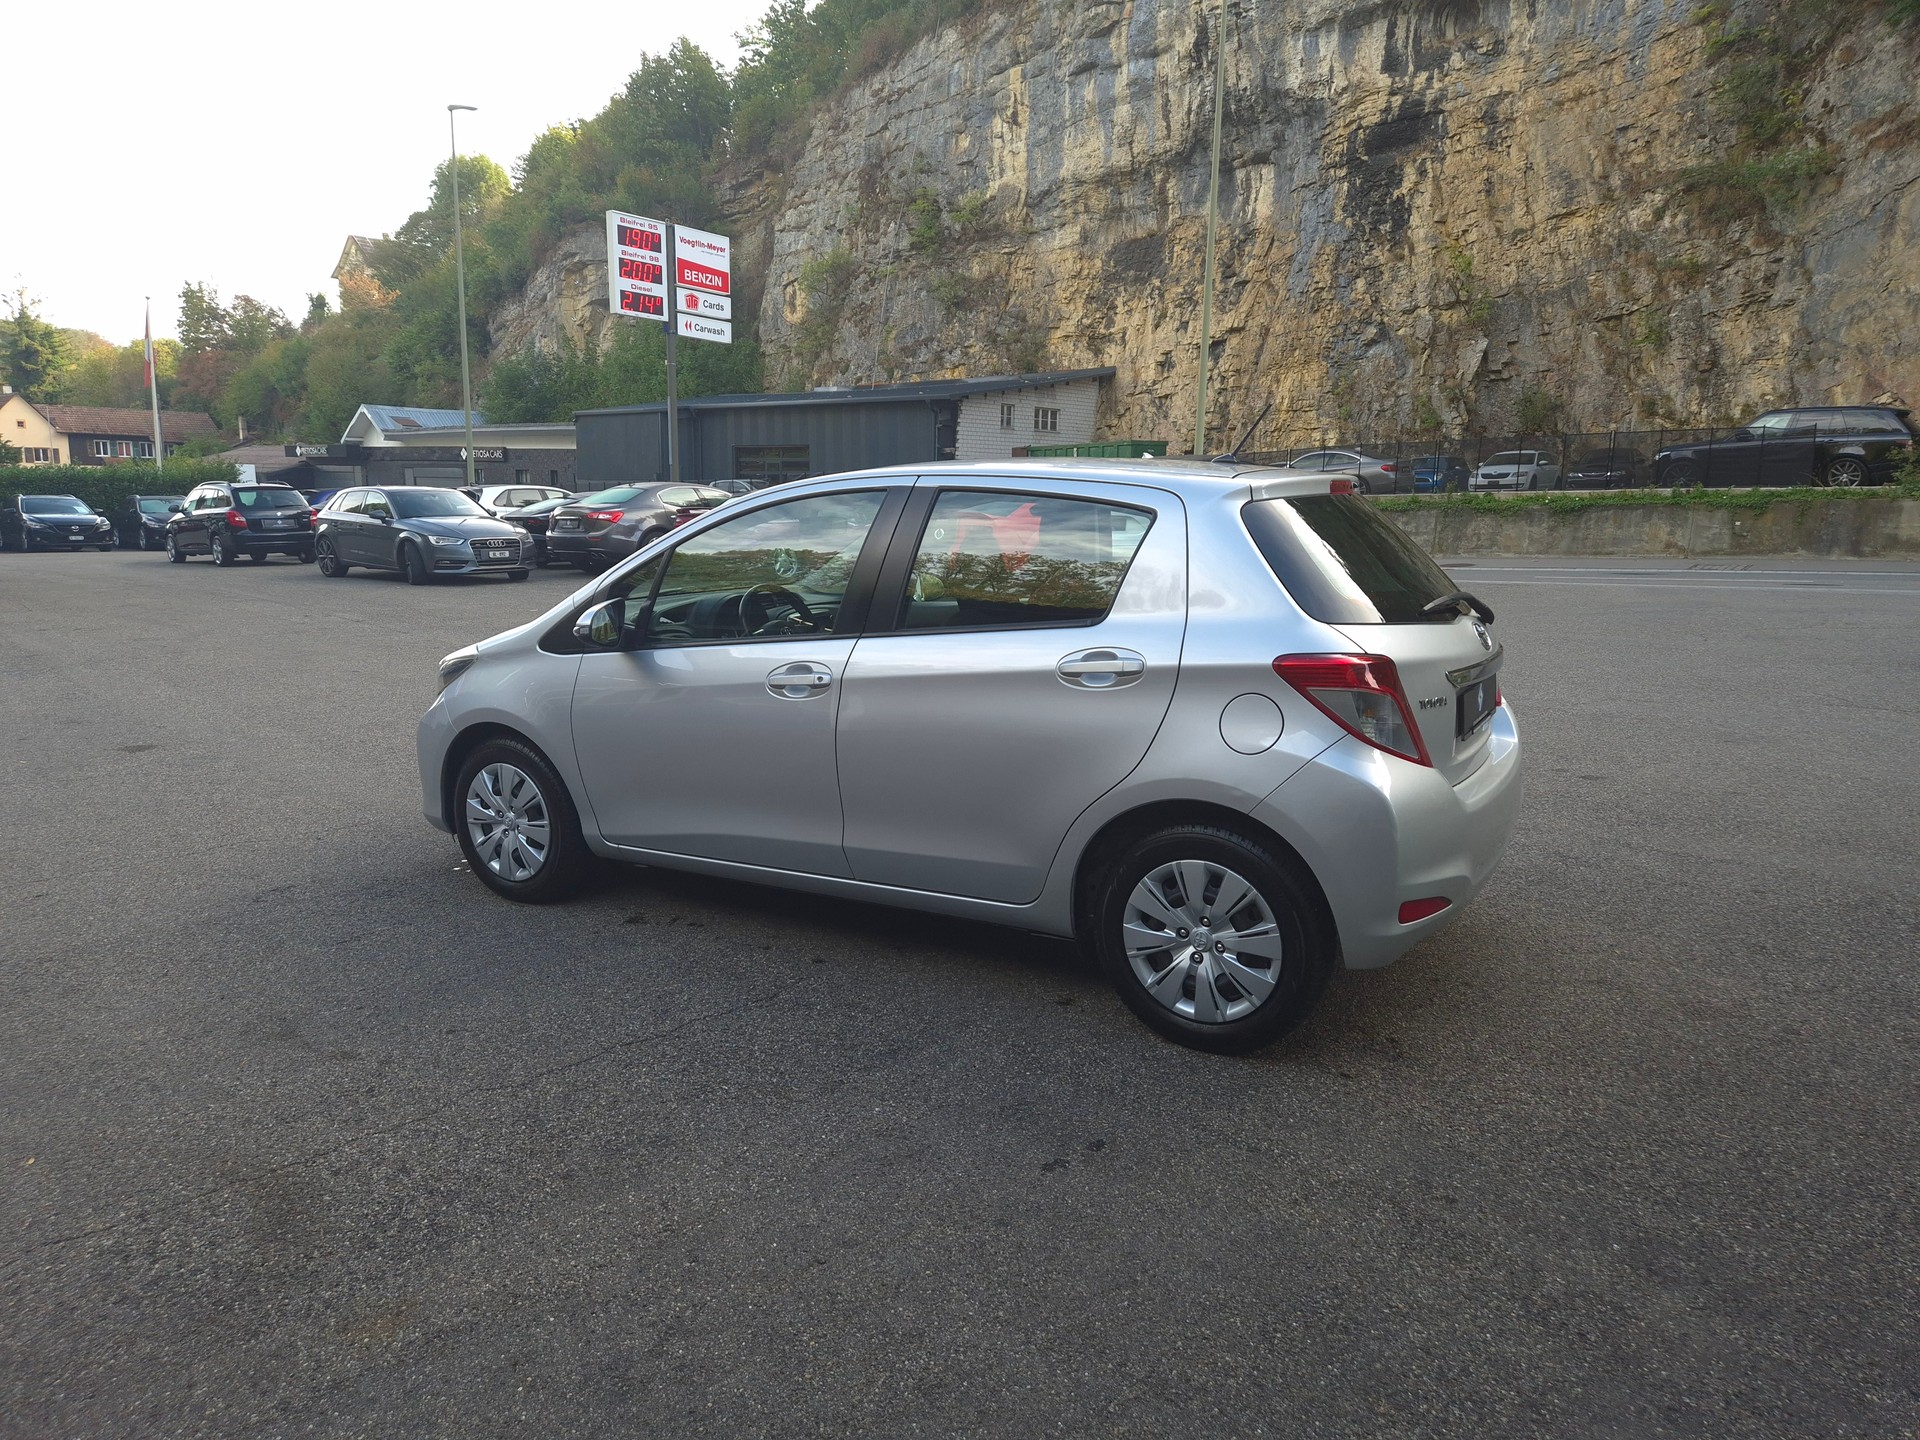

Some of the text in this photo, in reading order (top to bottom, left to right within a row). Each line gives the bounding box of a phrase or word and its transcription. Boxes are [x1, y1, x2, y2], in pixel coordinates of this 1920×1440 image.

[620, 217, 658, 231] Bleifrei 95
[621, 250, 646, 259] Bleifrei
[684, 269, 722, 287] BENZIN
[631, 284, 652, 292] Diesel
[703, 299, 725, 311] Cards
[694, 323, 725, 336] Carwash
[490, 449, 503, 459] CARS
